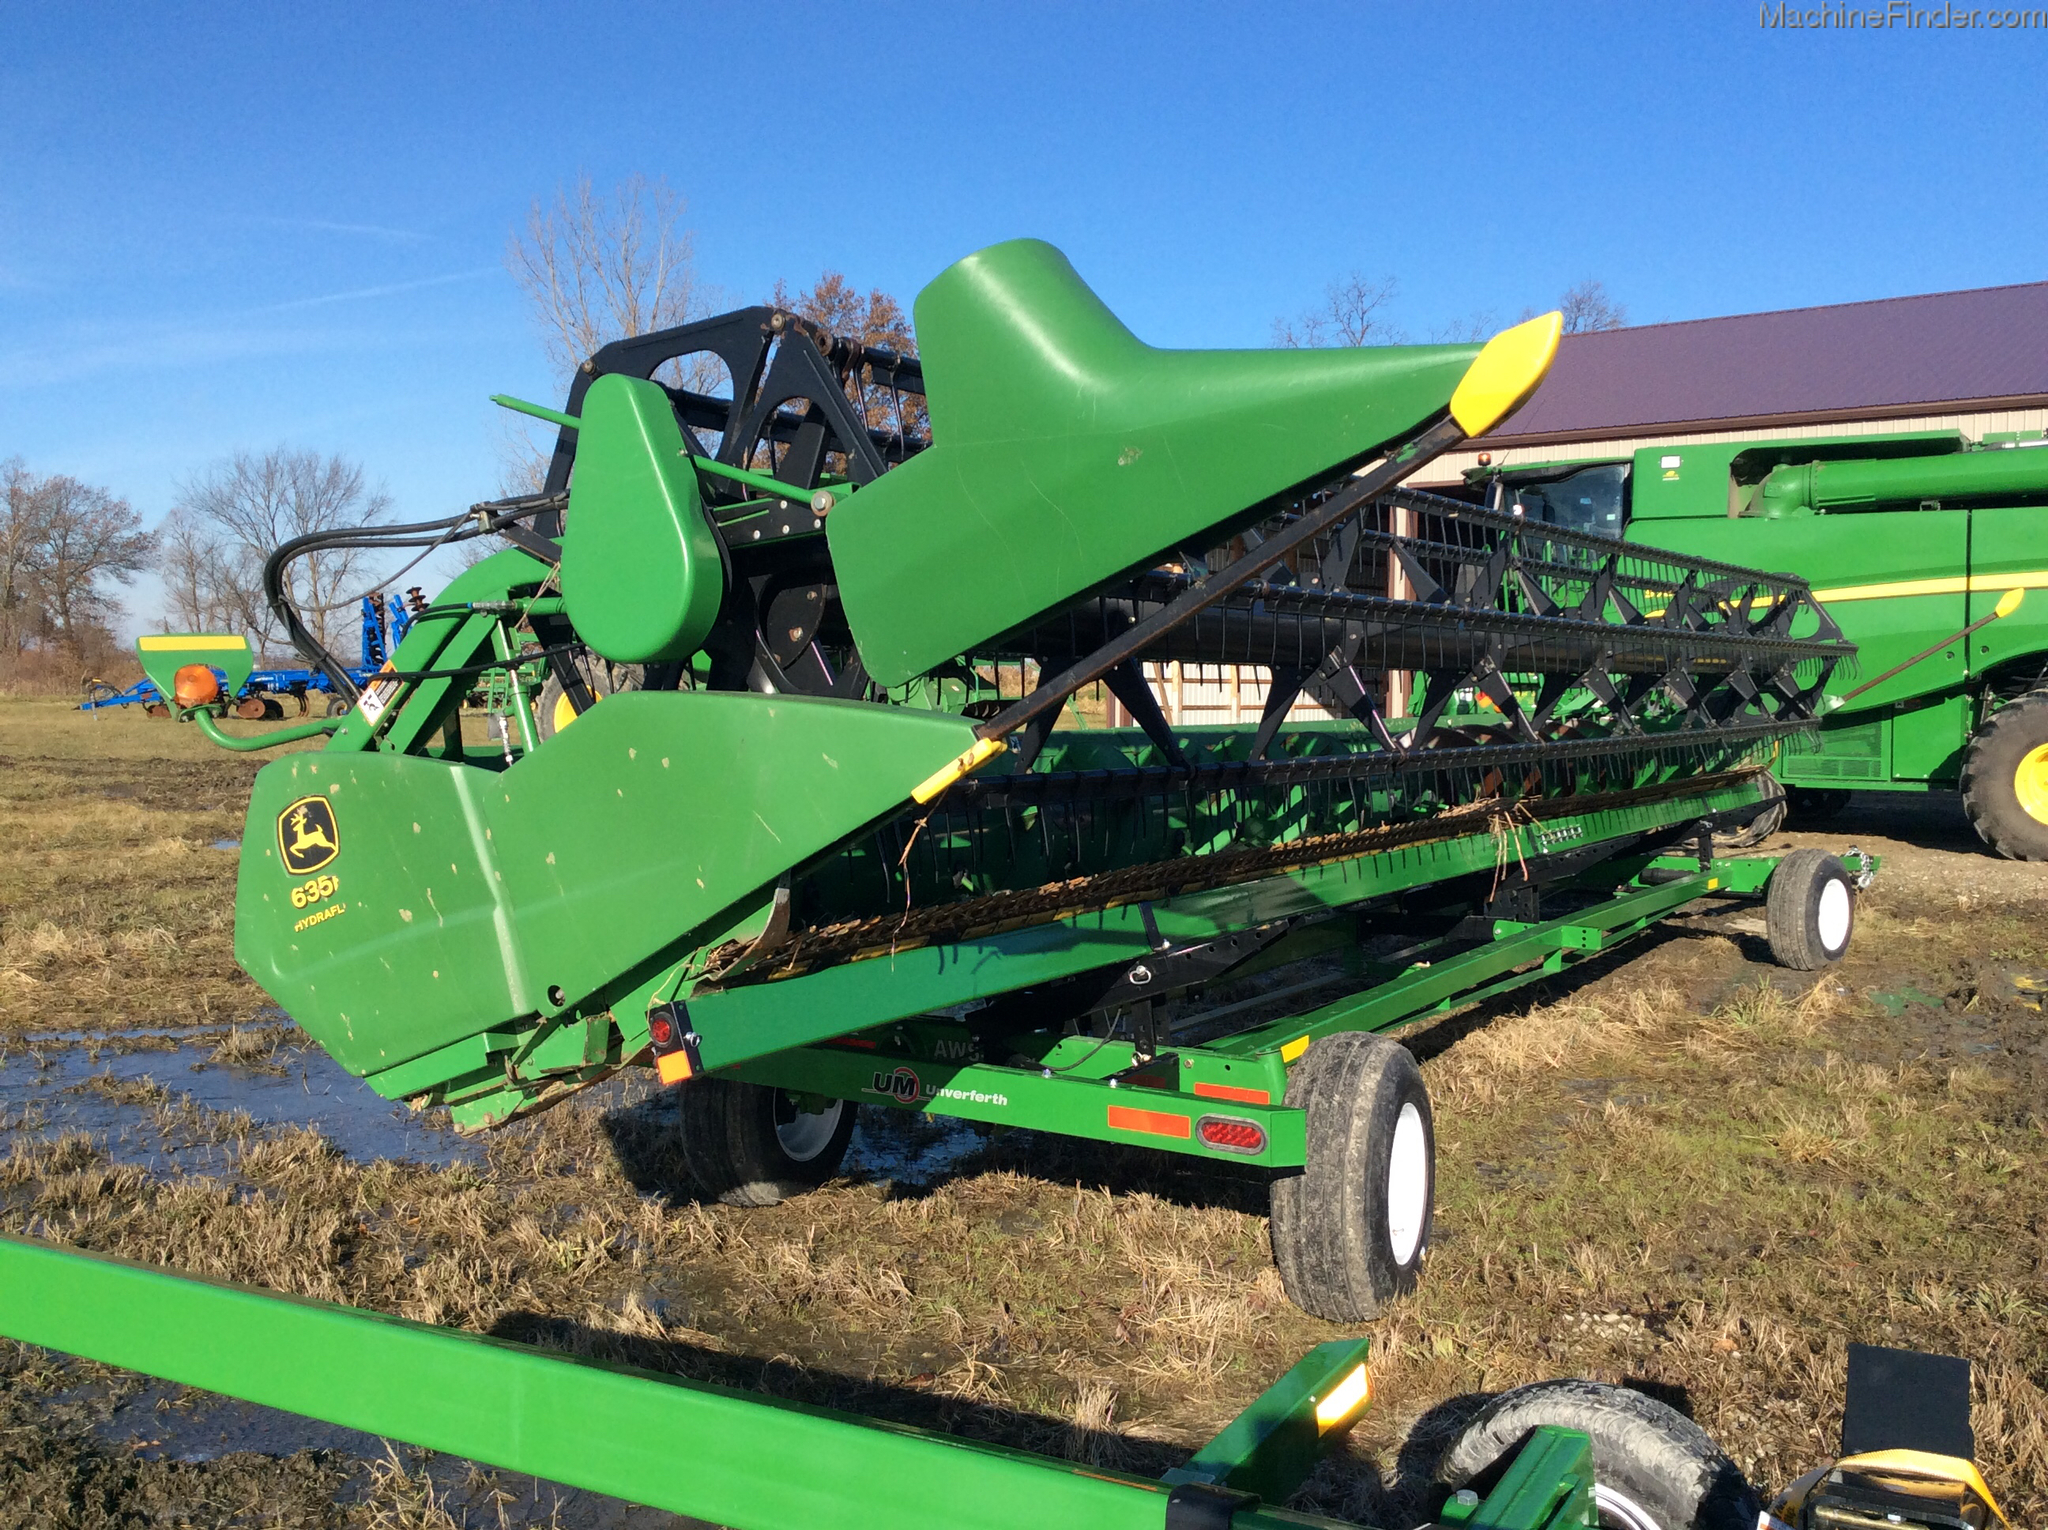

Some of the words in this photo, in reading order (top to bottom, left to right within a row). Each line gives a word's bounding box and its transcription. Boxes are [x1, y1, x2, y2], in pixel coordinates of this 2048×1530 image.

[294, 902, 347, 932] HYDRAFL
[873, 1071, 917, 1097] UM
[925, 1083, 1008, 1107] Unverferth
